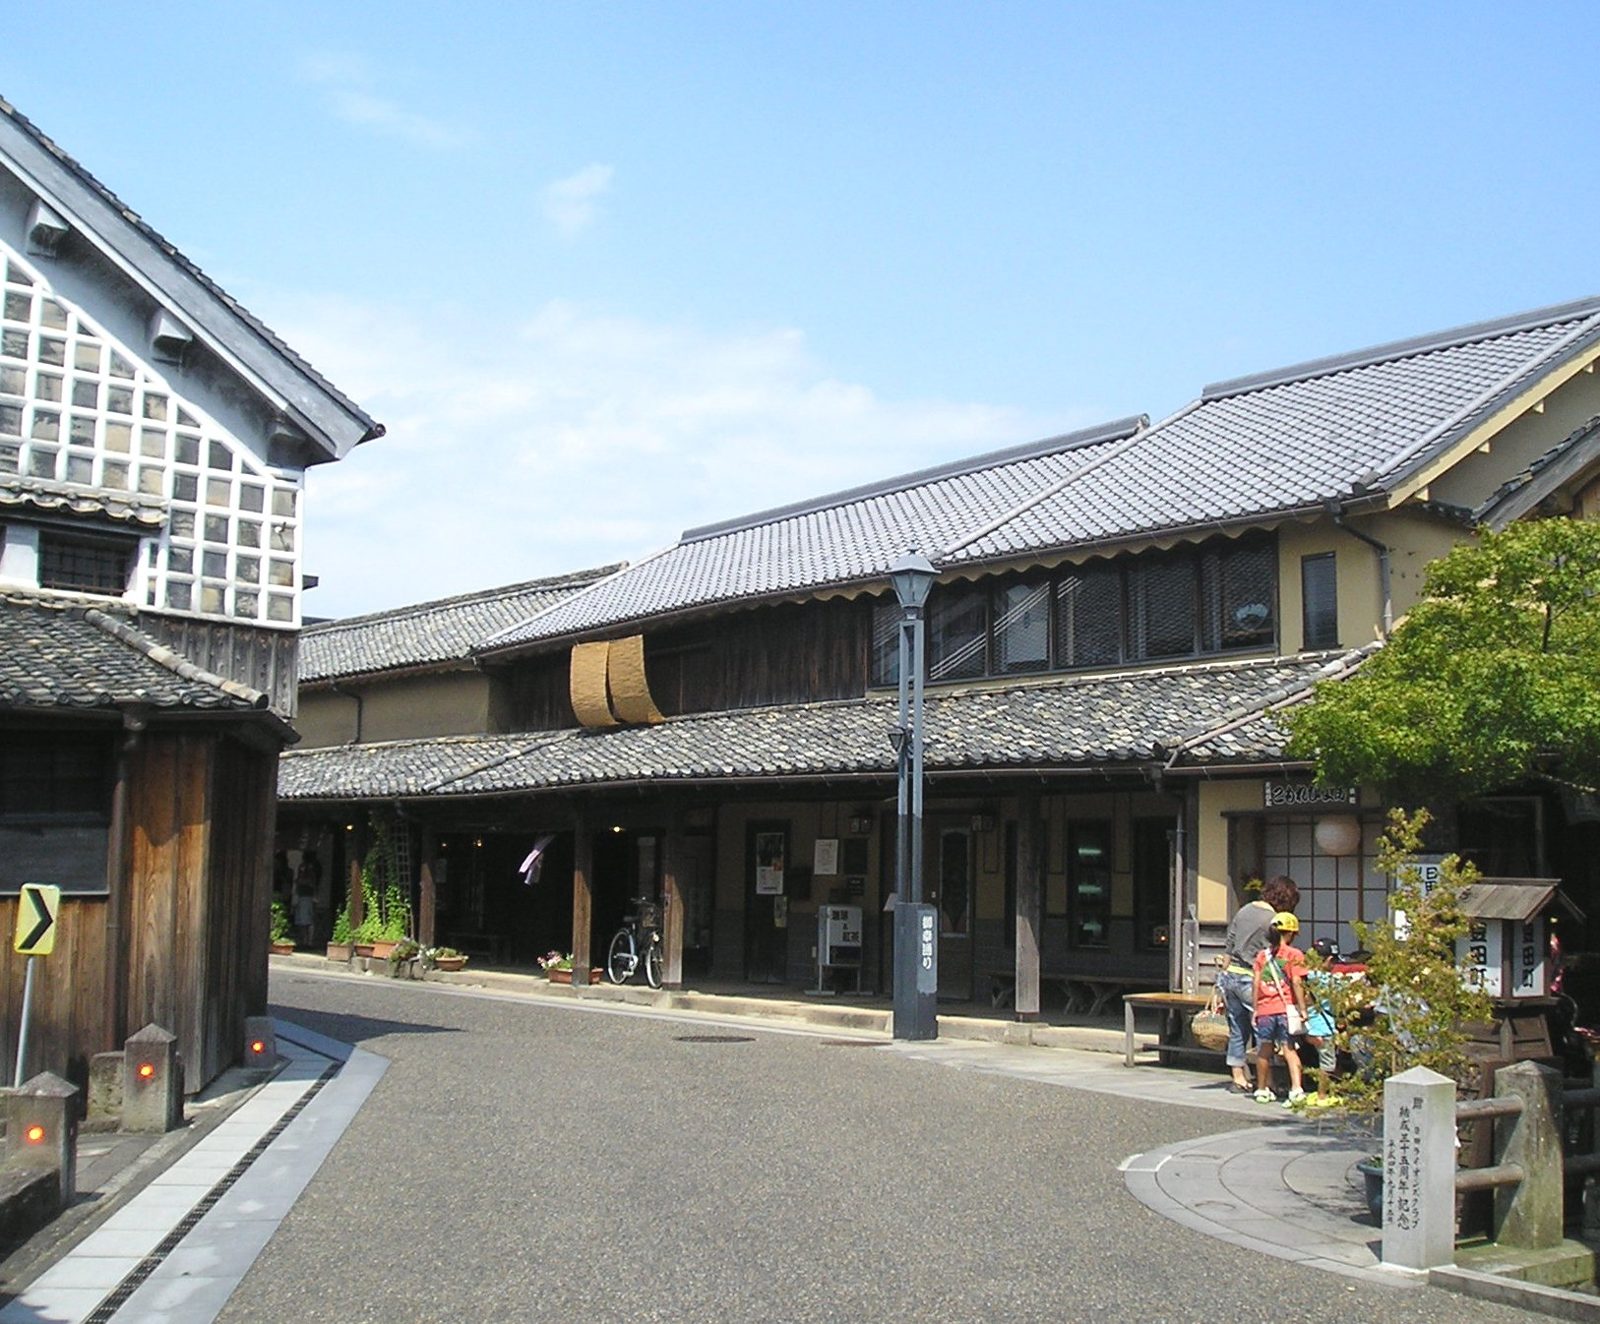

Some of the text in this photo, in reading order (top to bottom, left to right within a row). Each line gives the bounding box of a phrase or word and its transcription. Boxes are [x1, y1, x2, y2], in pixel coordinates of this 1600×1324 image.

[843, 931, 860, 943] 紅茶
[1397, 1105, 1410, 1231] 結成三十五周年記念
